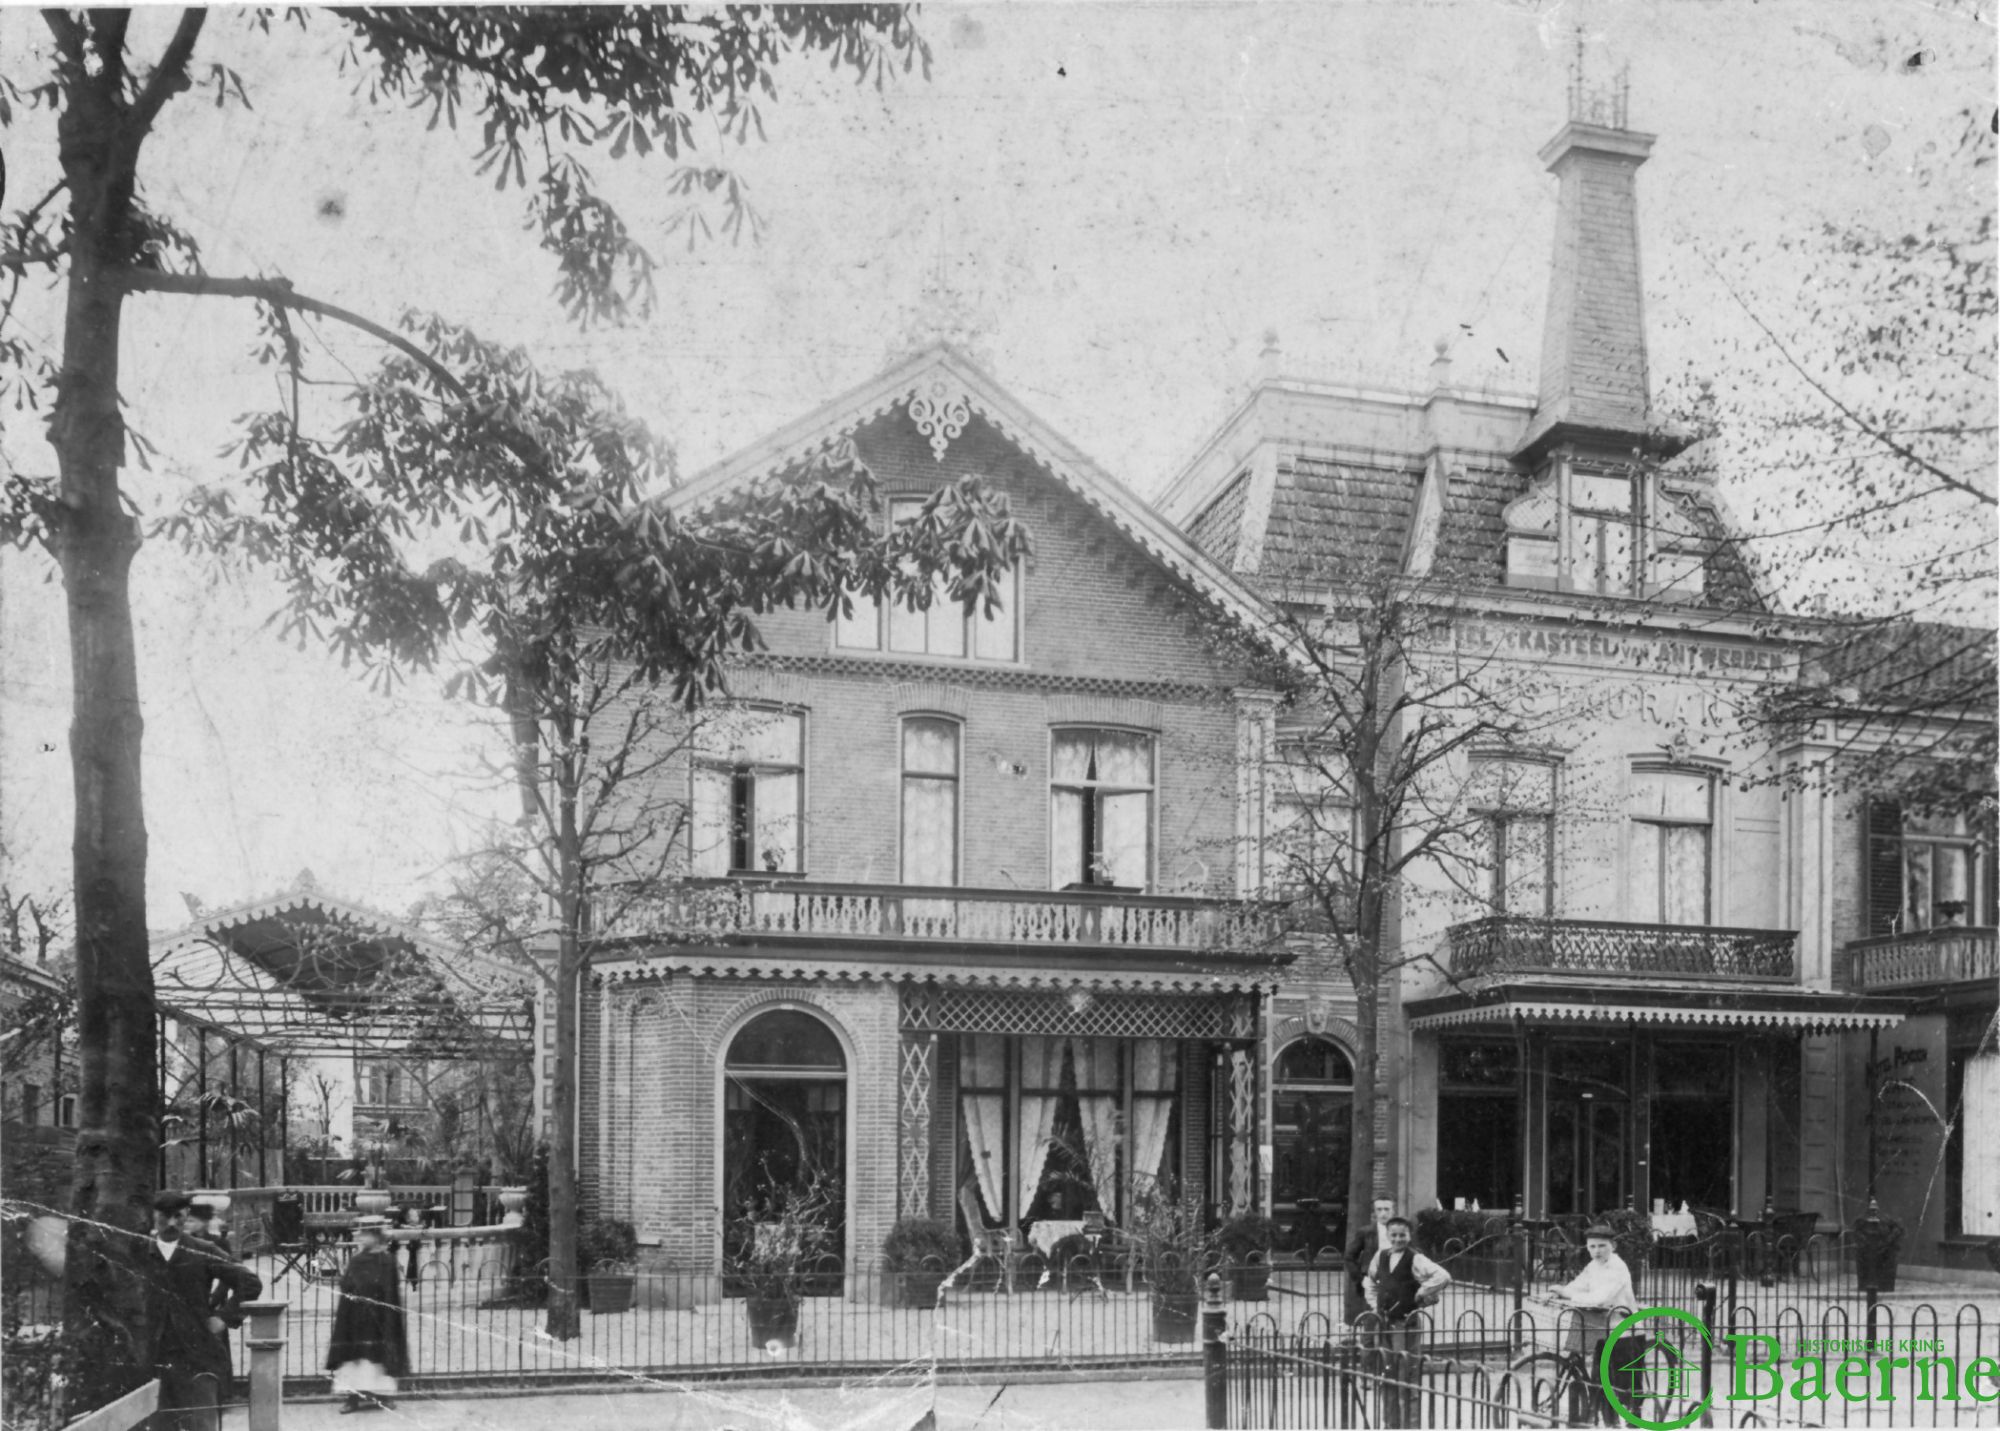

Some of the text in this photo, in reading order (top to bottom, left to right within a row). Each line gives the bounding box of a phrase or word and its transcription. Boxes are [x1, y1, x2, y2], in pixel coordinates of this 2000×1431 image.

[1519, 631, 1619, 657] KASTEEL
[1659, 642, 1783, 672] ANTWERPEN
[1454, 676, 1754, 730] RSTURAN
